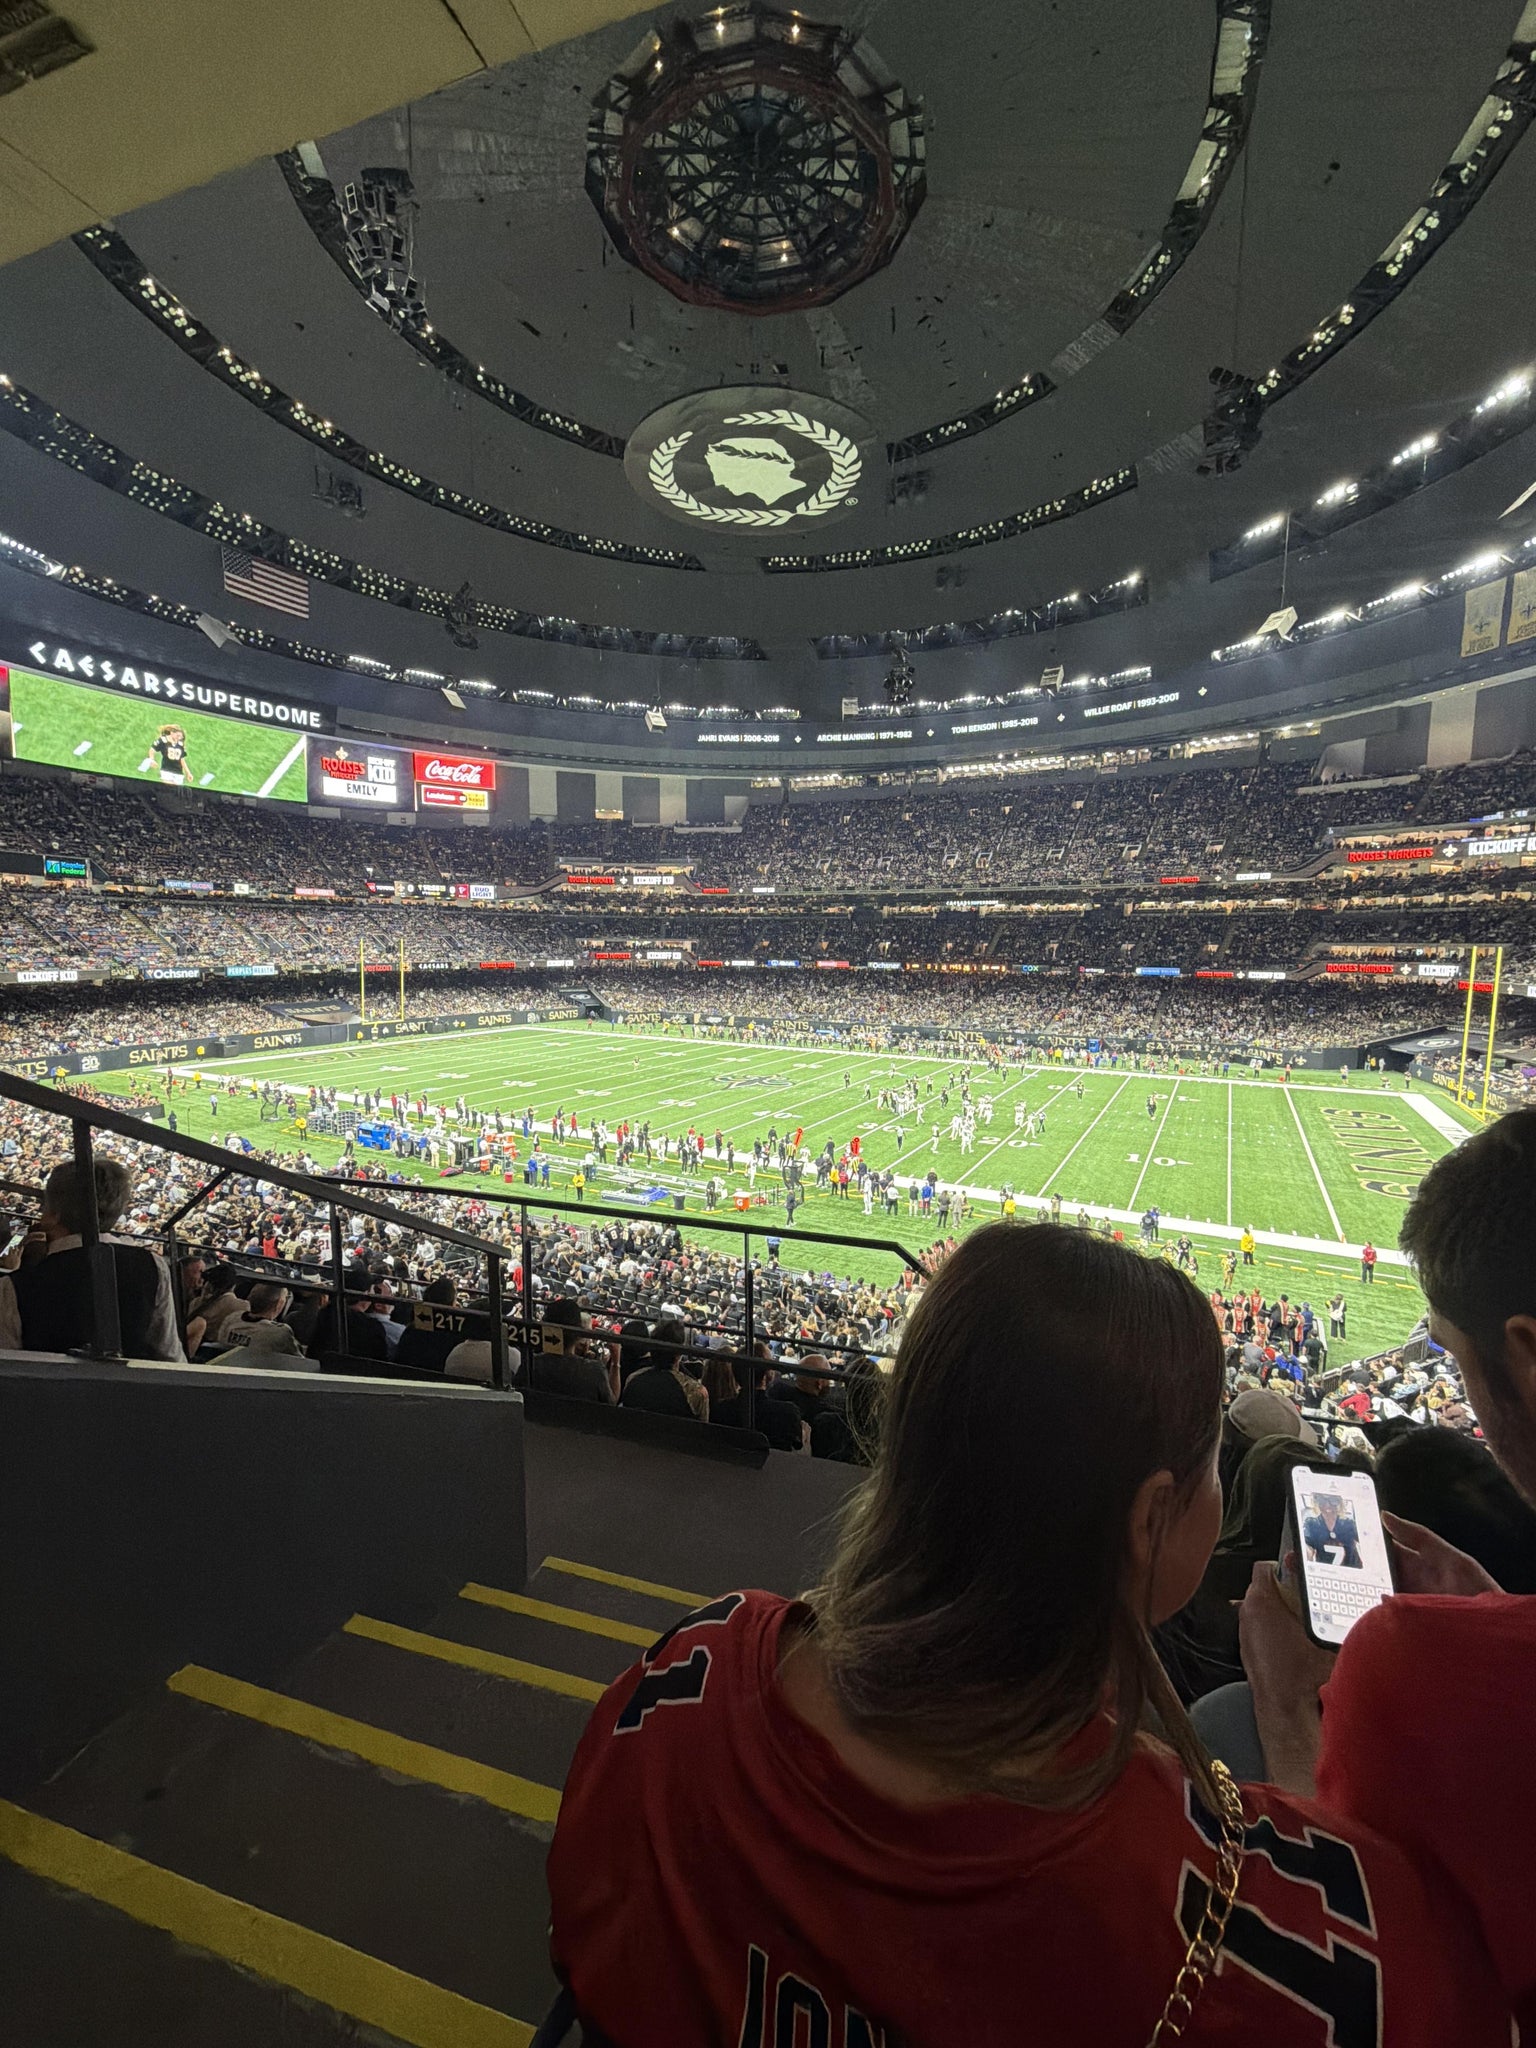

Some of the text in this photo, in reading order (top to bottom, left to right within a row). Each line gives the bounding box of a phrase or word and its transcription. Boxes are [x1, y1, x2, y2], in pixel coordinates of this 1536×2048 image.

[29, 641, 321, 728] CAESARS SUPERDOME
[1084, 706, 1110, 718] WILLIE
[1111, 702, 1133, 713] ROAF
[951, 726, 968, 735] TOM
[968, 722, 997, 733] BENSON
[817, 734, 841, 742] ARCHIE
[321, 756, 366, 775] ROUSES
[346, 783, 378, 796] EMILY
[1468, 838, 1527, 856] KICKOFF
[1348, 847, 1434, 863] ROUSES MARKETS
[154, 969, 200, 979] Ochsner
[364, 964, 393, 972] verizon
[1022, 964, 1039, 972] COX
[478, 1014, 512, 1026] SAINTS
[548, 1009, 579, 1020] SAINTS
[772, 1020, 809, 1031] SAINTS
[318, 1239, 330, 1250] 21
[435, 1312, 466, 1332] 217
[508, 1325, 541, 1345] 215
[1323, 1544, 1346, 1566] 7
